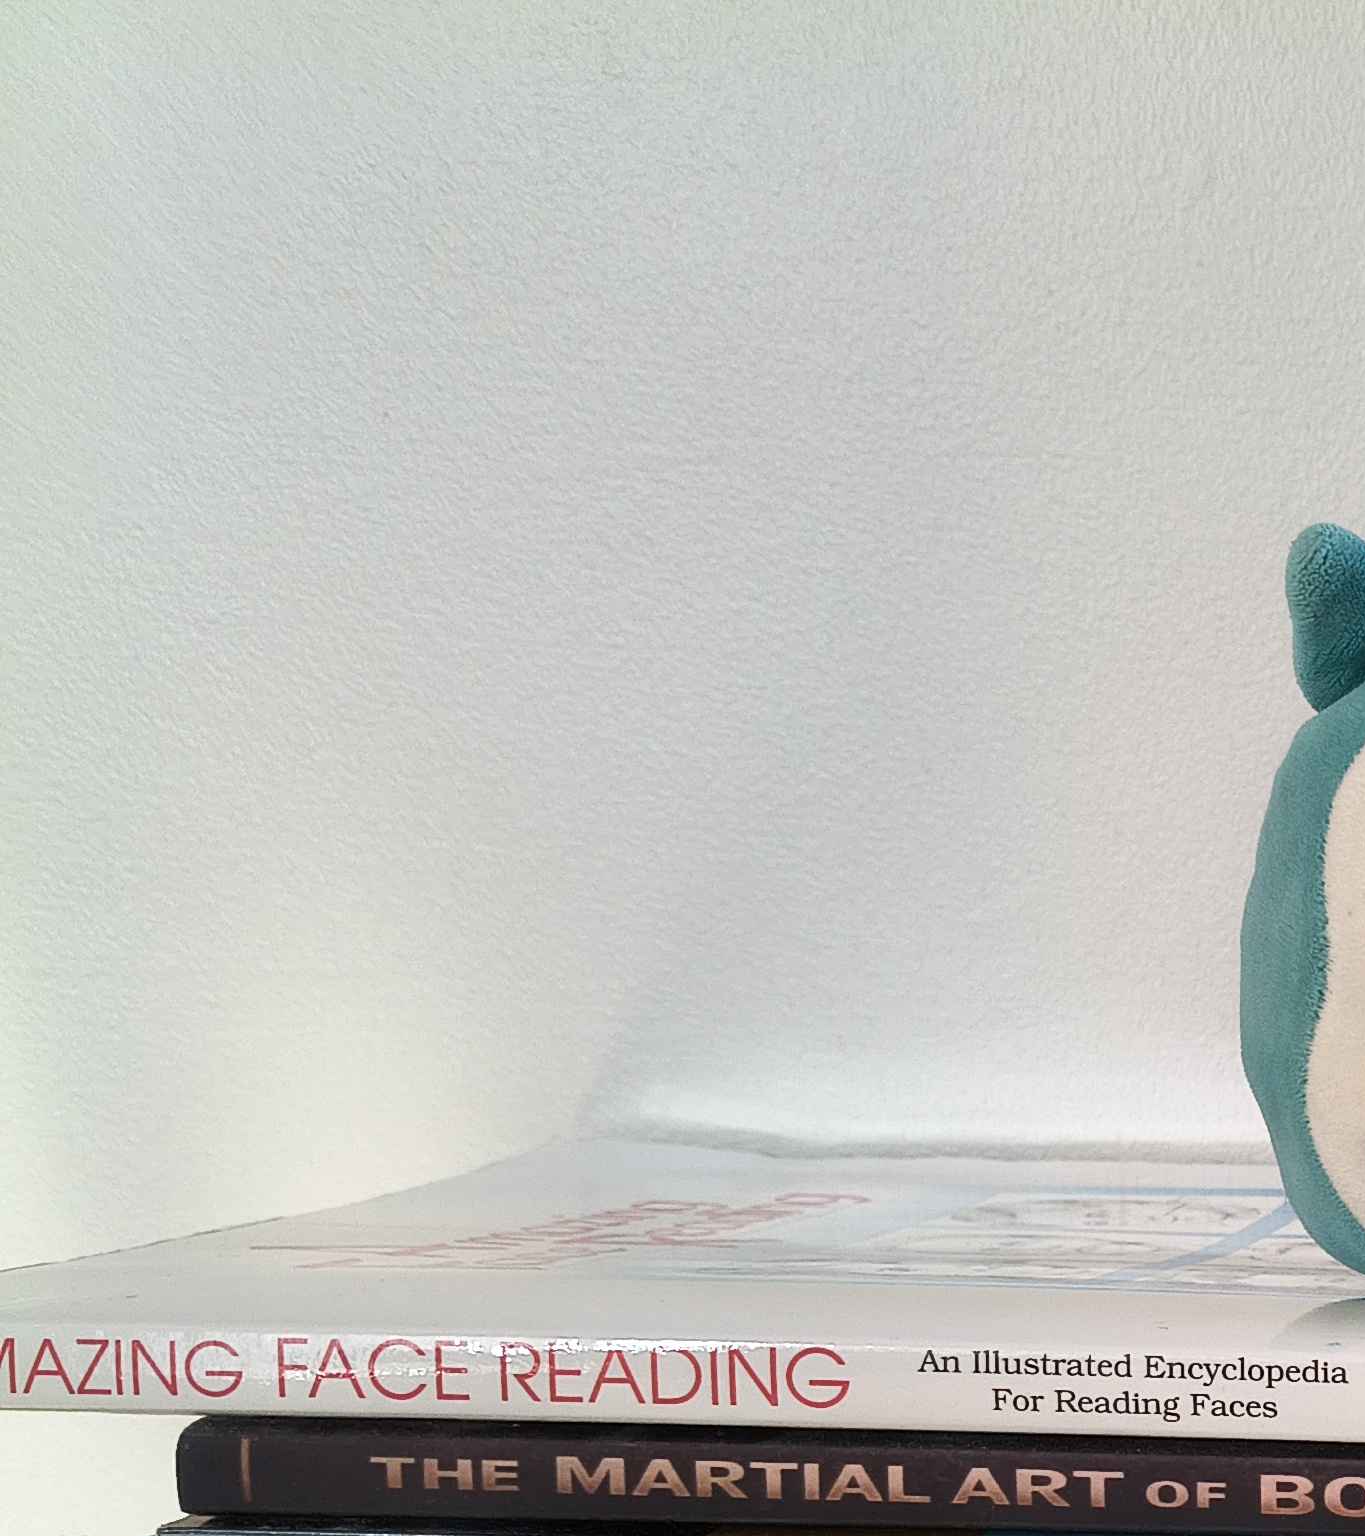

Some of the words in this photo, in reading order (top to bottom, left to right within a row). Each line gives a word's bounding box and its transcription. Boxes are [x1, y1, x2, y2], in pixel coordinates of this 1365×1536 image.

[278, 1338, 472, 1400] FACE
[497, 1341, 850, 1408] READING
[918, 1350, 961, 1373] An
[973, 1350, 1132, 1377] Illustrated
[1144, 1356, 1348, 1388] Encyclopedia
[992, 1389, 1044, 1412] For
[1055, 1390, 1180, 1422] Reading
[1190, 1394, 1277, 1418] Faces
[370, 1457, 519, 1490] THE
[556, 1456, 930, 1502] MARTIAL
[952, 1468, 1124, 1507] ART
[1146, 1481, 1226, 1508] OF
